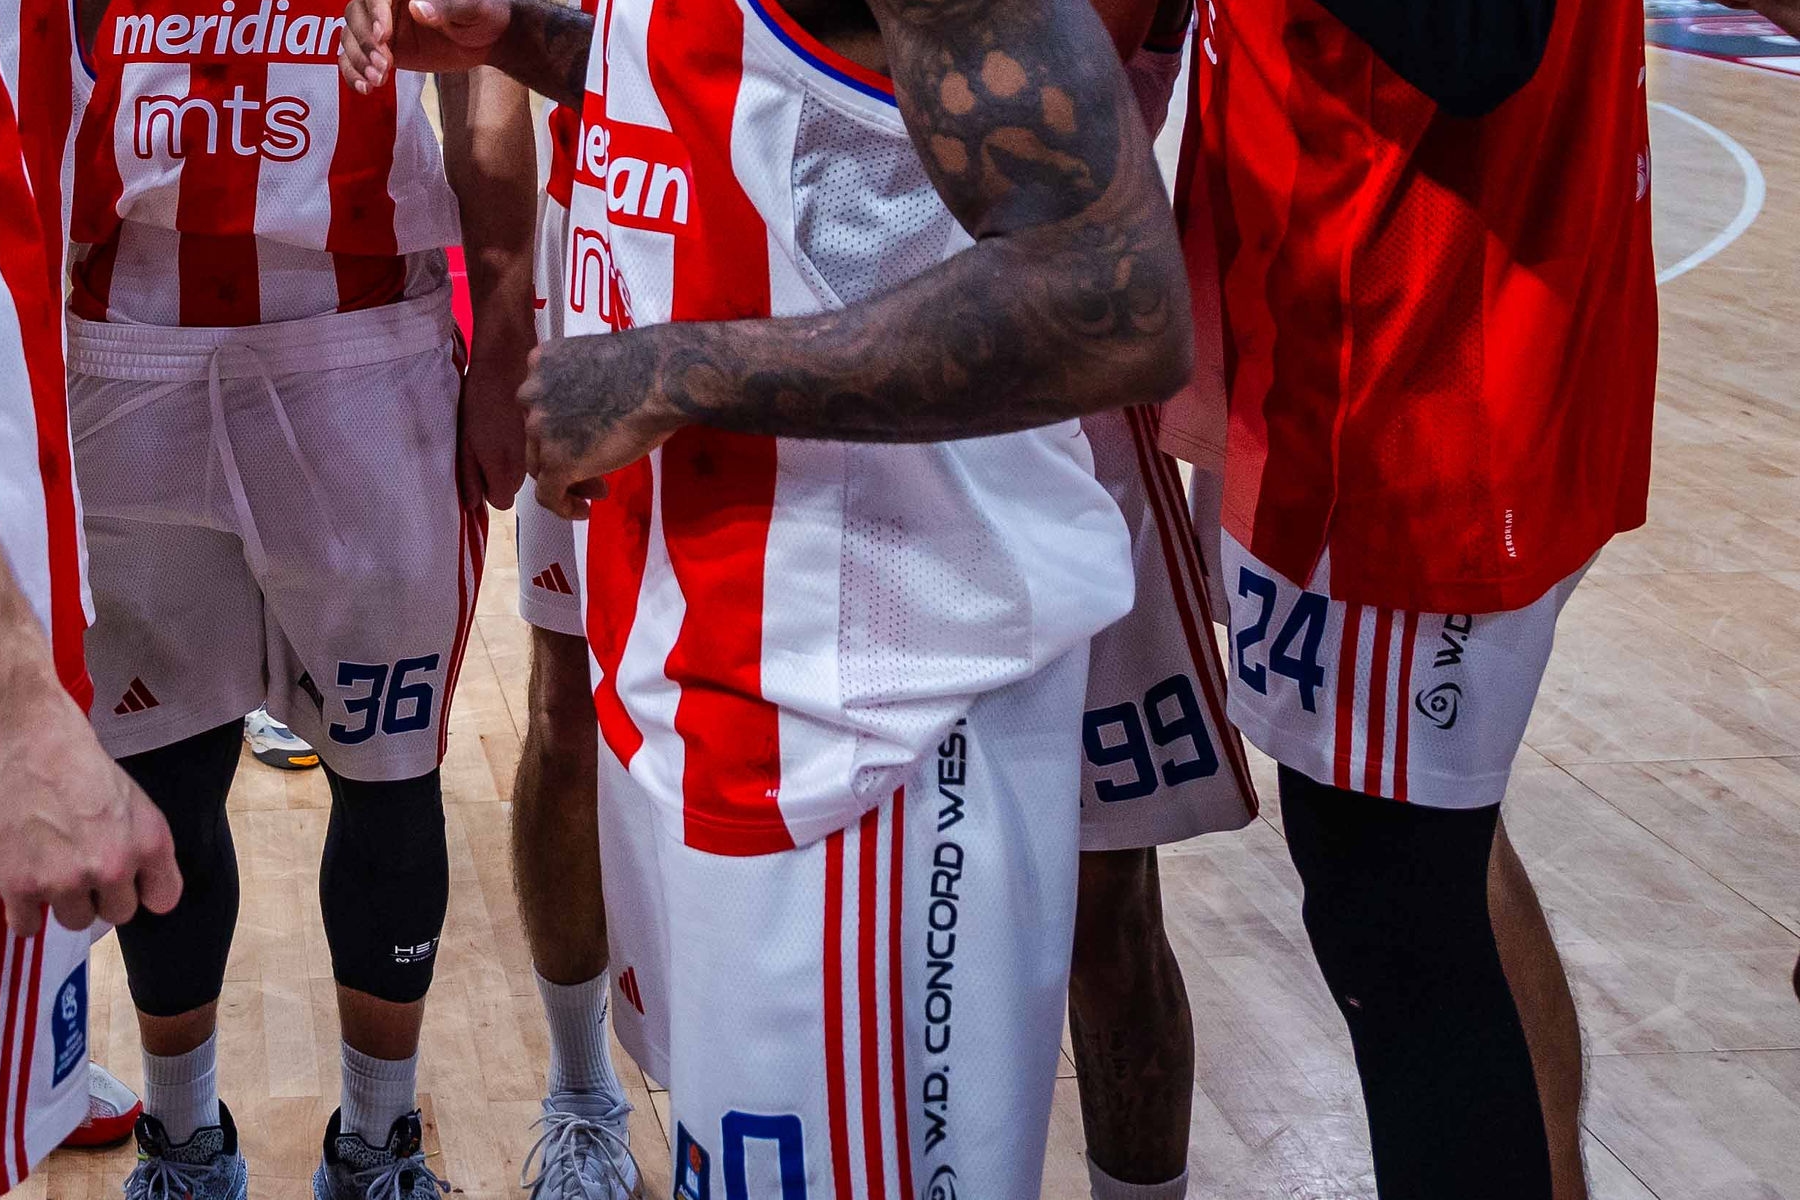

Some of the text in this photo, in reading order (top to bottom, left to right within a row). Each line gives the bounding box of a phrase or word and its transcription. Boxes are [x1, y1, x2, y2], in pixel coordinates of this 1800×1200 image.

[134, 84, 310, 162] mts
[1236, 565, 1330, 714] 24
[328, 652, 441, 745] 36
[1082, 673, 1219, 802] 99
[924, 841, 966, 1054] CONCORD
[923, 1064, 951, 1157] W.D.
